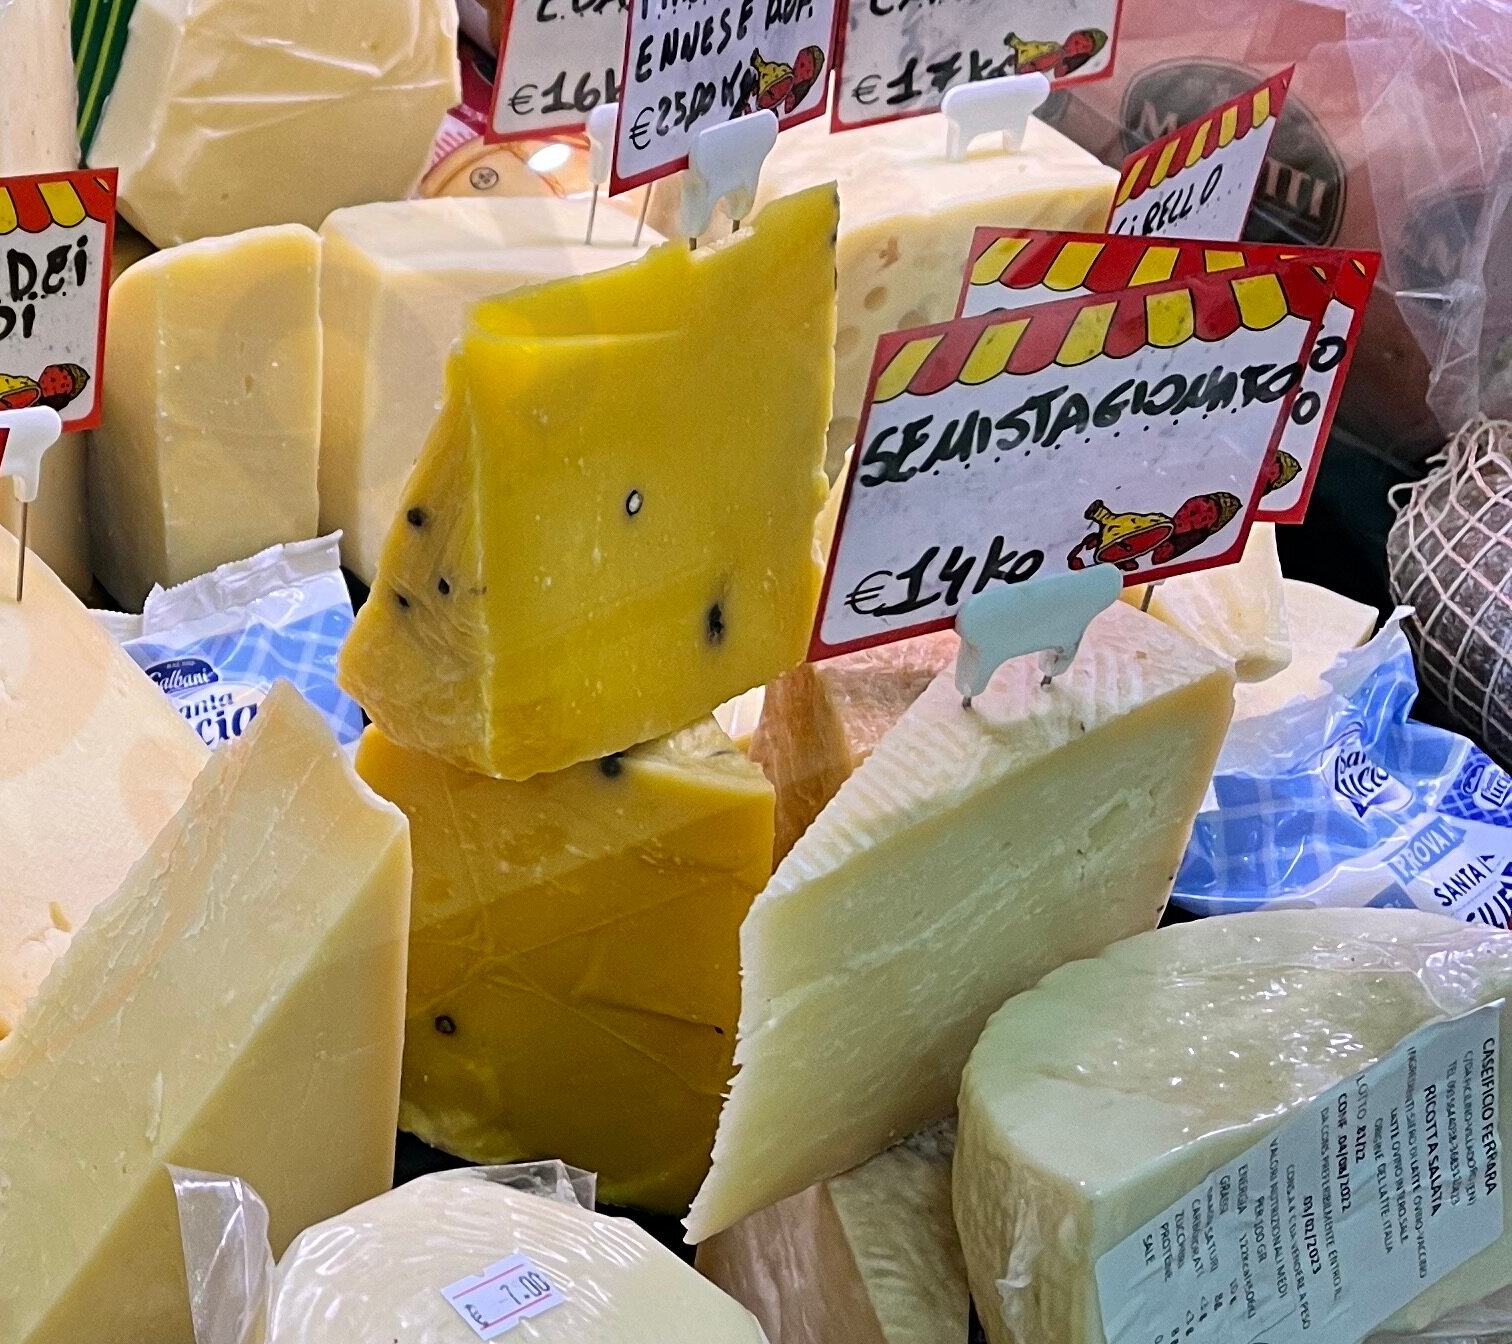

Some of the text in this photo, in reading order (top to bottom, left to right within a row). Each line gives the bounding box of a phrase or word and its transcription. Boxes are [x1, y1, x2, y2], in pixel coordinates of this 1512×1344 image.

[9, 233, 89, 292] DEI
[859, 361, 1301, 489] SEMISTAGIONATO
[179, 688, 235, 720] anta
[1423, 1081, 1442, 1218] RICOTTA SALATA
[1479, 1035, 1497, 1199] CASEIFICIO FERRARA
